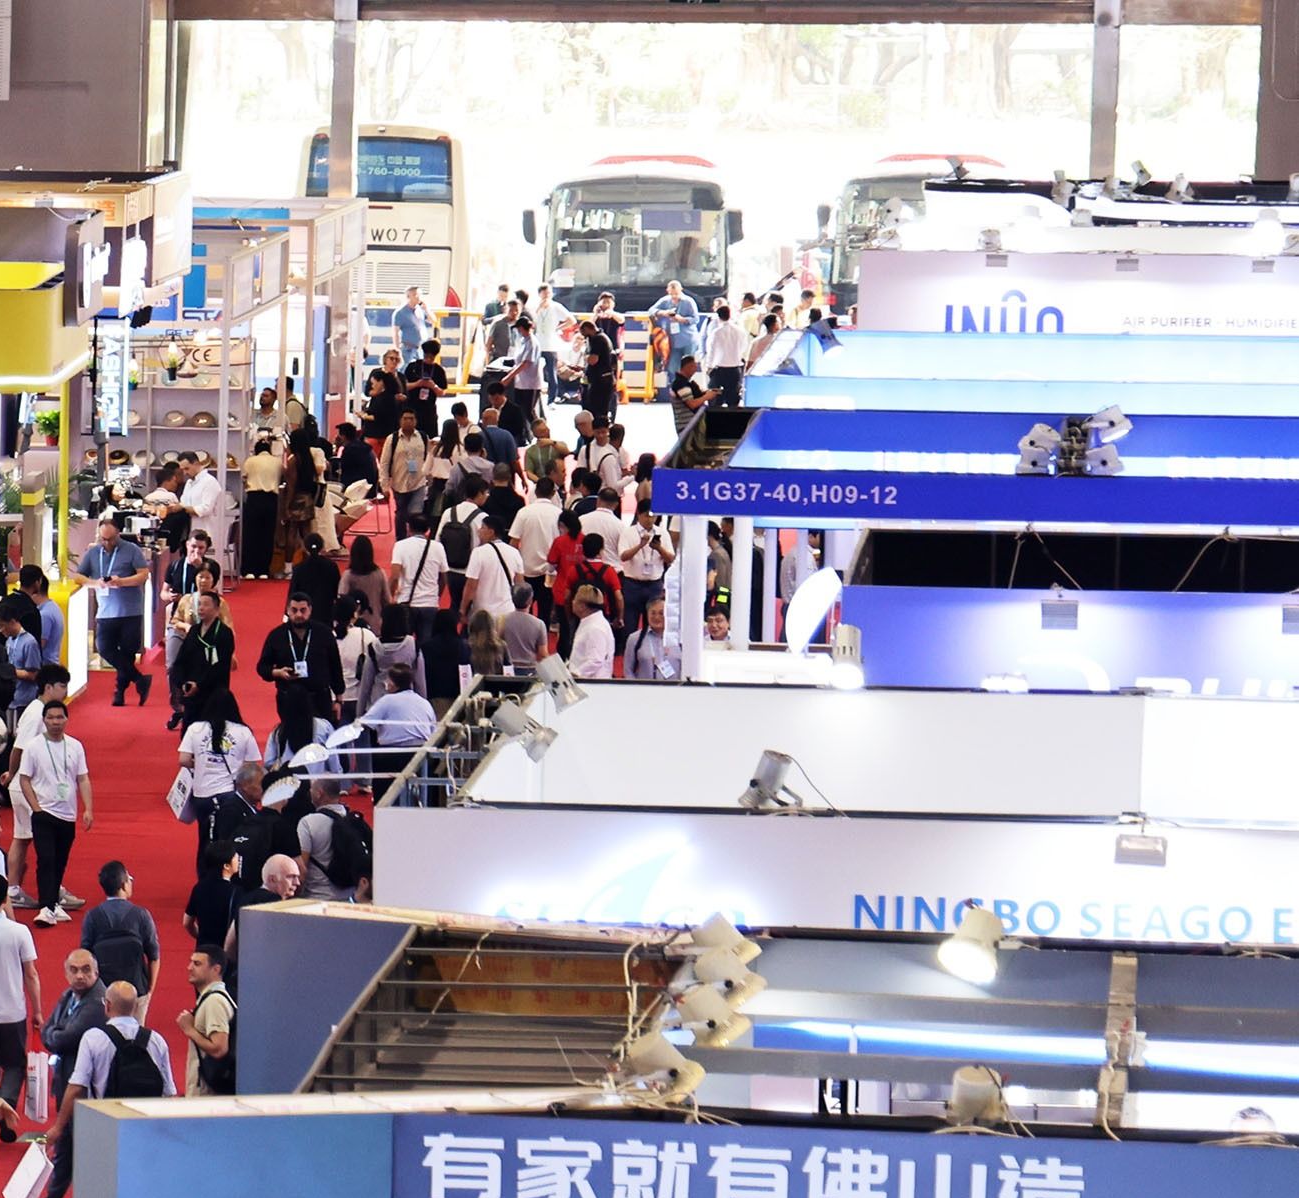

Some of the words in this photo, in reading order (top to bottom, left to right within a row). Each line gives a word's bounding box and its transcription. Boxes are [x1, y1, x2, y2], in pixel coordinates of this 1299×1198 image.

[357, 166, 421, 176] -760-8000
[675, 480, 898, 506] 3.1G37-40,H09-12
[1080, 903, 1253, 943] SEAGO
